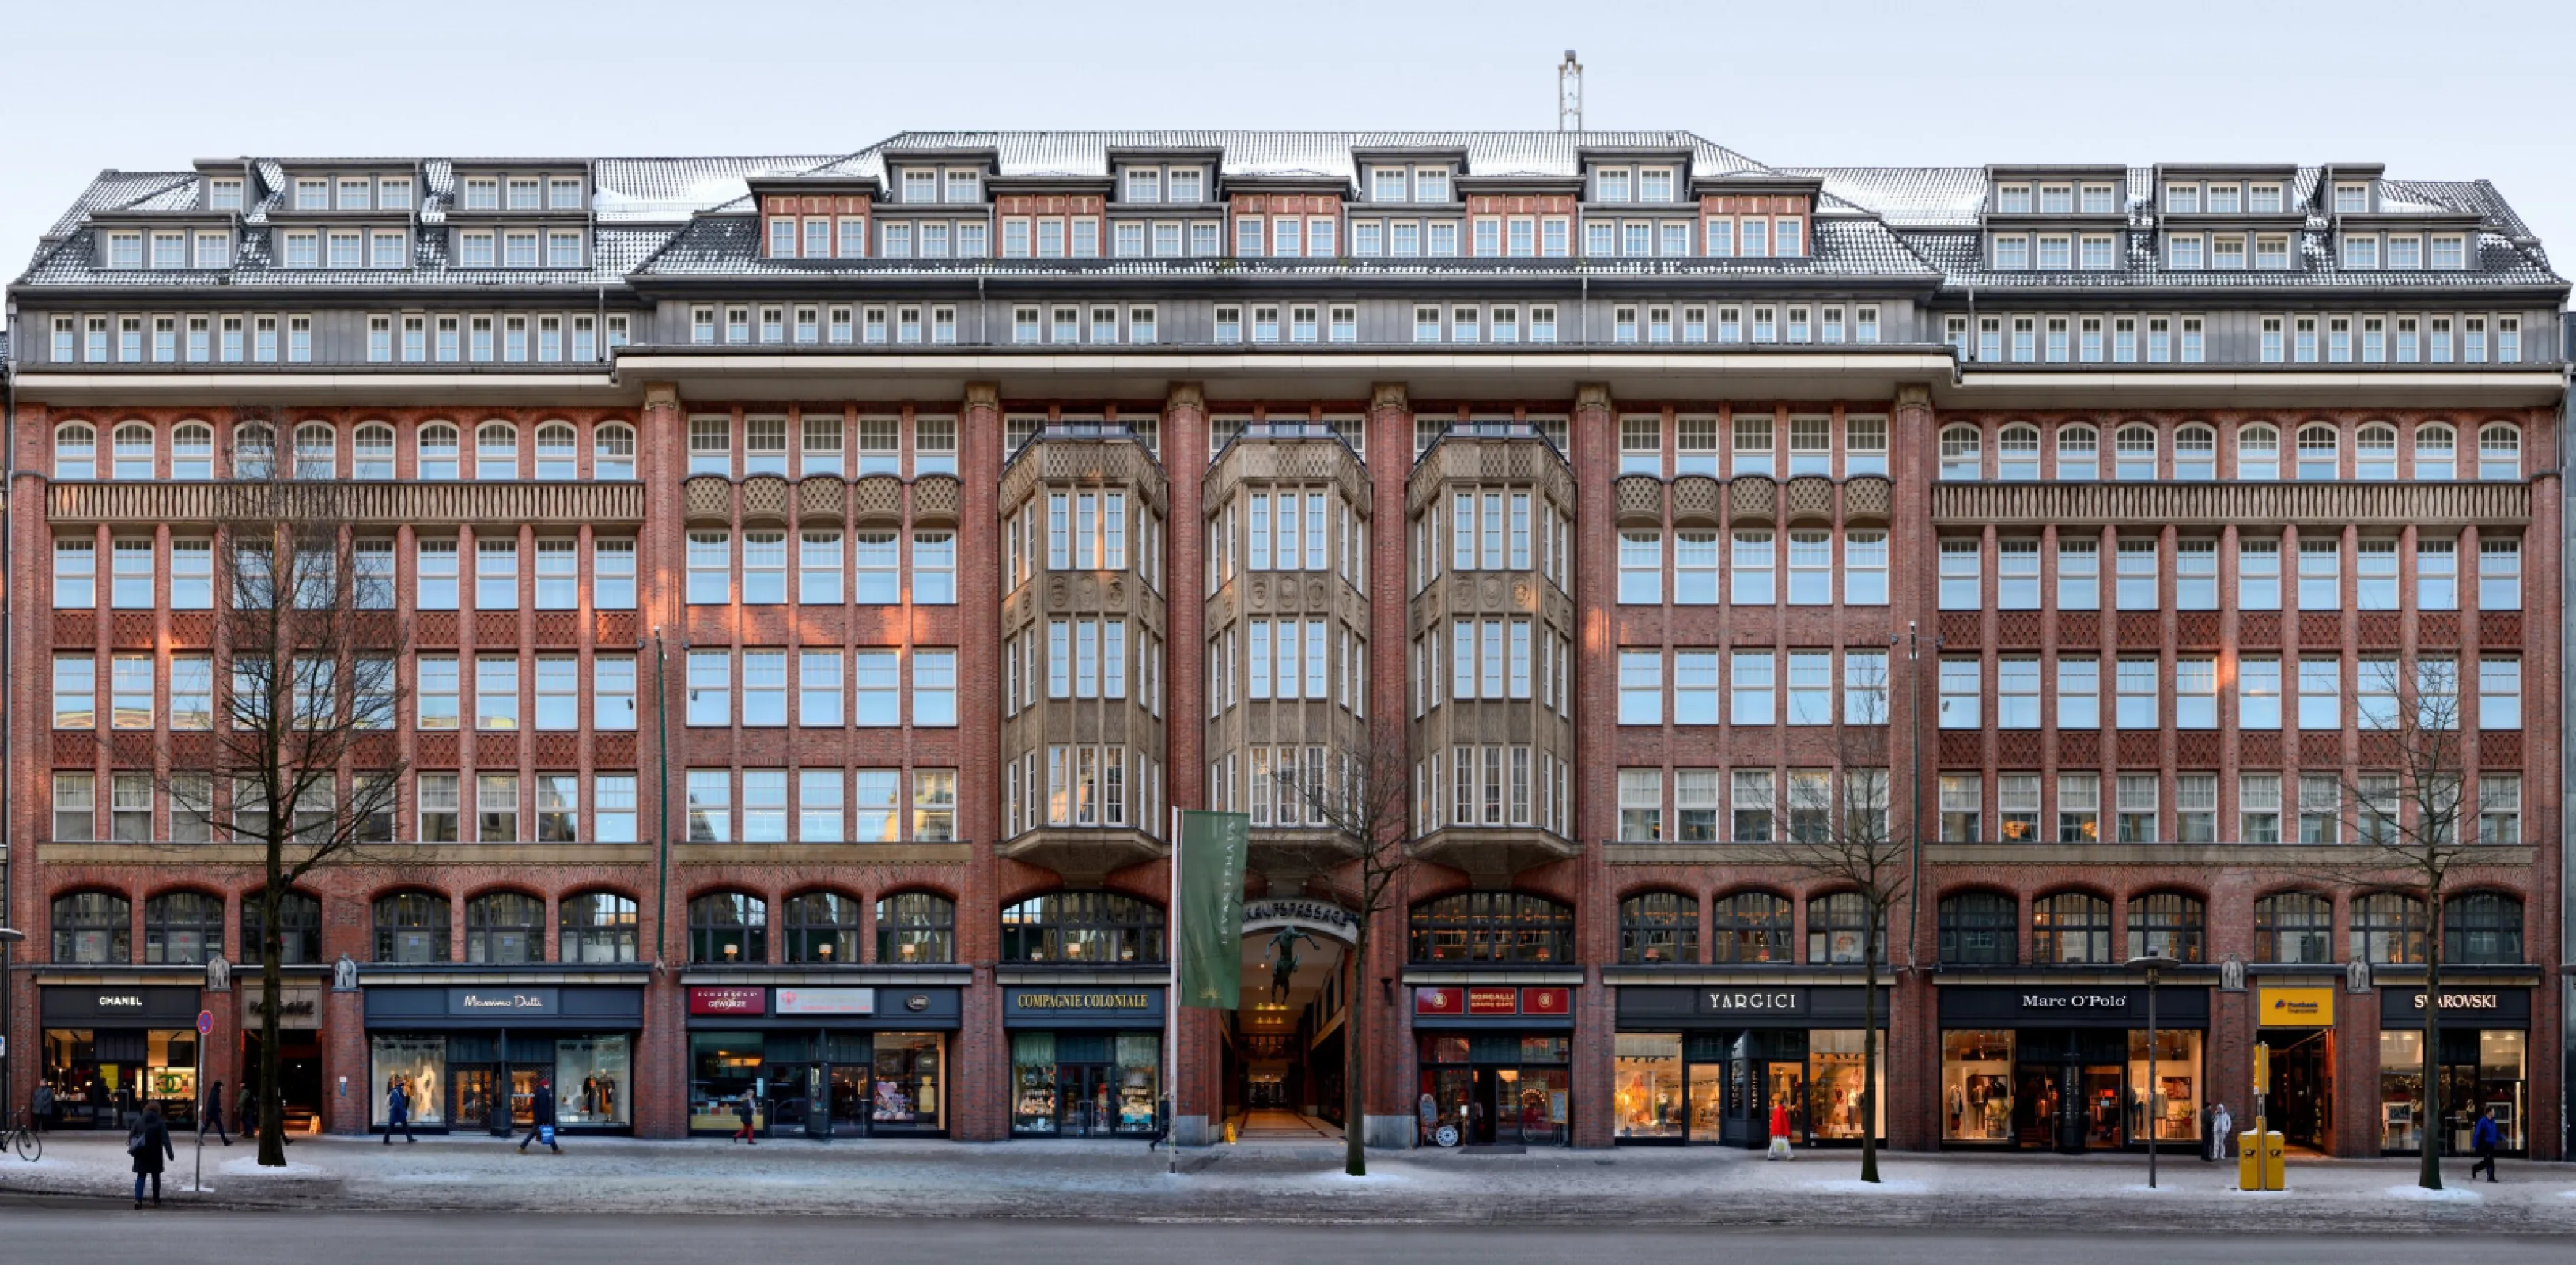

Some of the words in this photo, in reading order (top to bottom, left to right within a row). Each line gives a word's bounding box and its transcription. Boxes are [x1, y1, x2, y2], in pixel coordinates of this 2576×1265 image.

[99, 995, 142, 1006] CHANEL
[464, 995, 512, 1007] Massimo
[513, 994, 543, 1008] Dutti
[1017, 994, 1082, 1009] COMPAGNIE
[1084, 994, 1148, 1009] COLONIALE
[1709, 993, 1796, 1008] YARGICI
[2022, 994, 2067, 1006] Marc
[2071, 994, 2126, 1006] O'Polo
[249, 1000, 315, 1015] PASAGE
